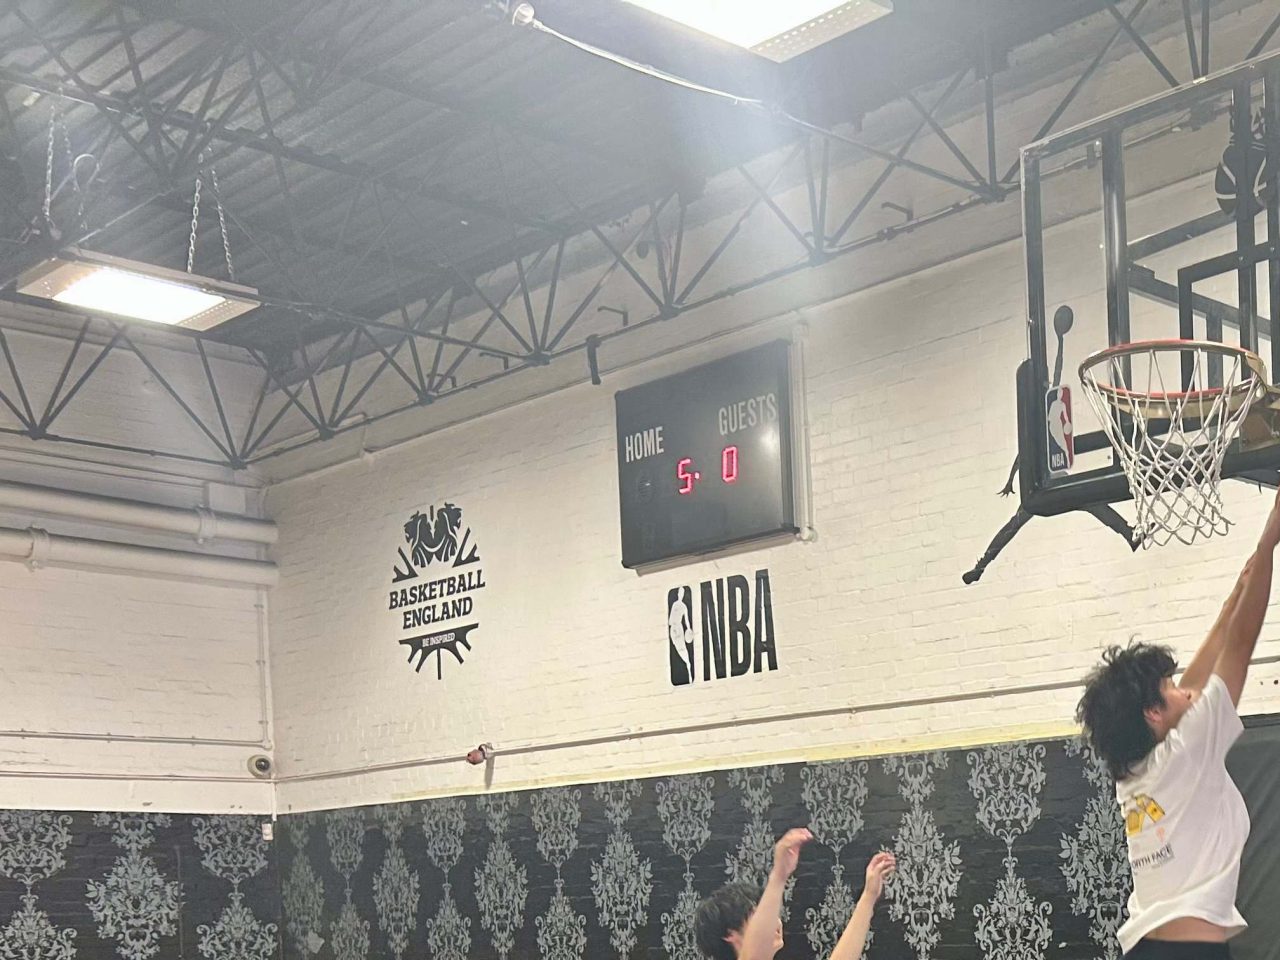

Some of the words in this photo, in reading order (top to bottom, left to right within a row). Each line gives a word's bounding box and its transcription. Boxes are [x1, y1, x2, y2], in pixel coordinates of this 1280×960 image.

[719, 393, 777, 435] GUESTS
[625, 426, 665, 463] HOME
[1052, 452, 1065, 467] NBA
[722, 446, 739, 483] 0
[388, 569, 486, 610] BASKETBALL
[403, 596, 473, 630] ENGLAND
[700, 569, 778, 681] NBA
[1131, 854, 1151, 870] ORTH
